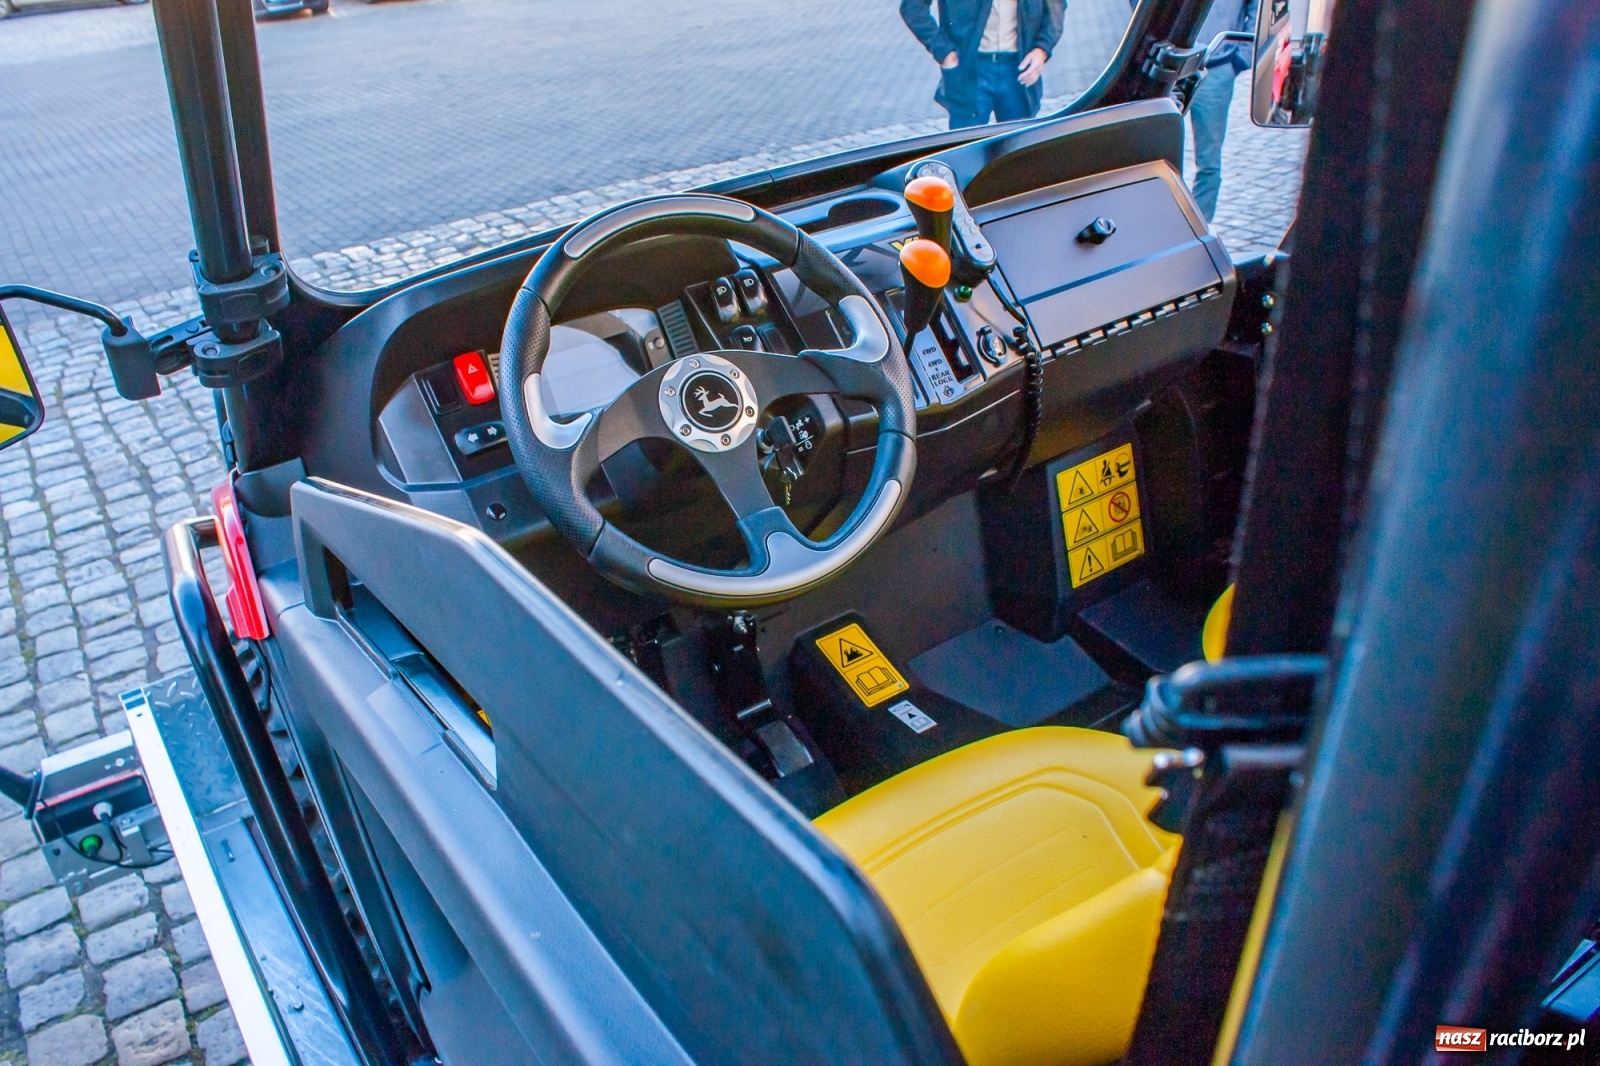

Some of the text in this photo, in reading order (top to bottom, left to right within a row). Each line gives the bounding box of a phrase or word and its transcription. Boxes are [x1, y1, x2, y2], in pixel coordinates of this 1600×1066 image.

[922, 346, 937, 356] 4WD
[927, 358, 943, 368] 4WD
[930, 370, 950, 380] REAR
[933, 376, 953, 386] LOCK
